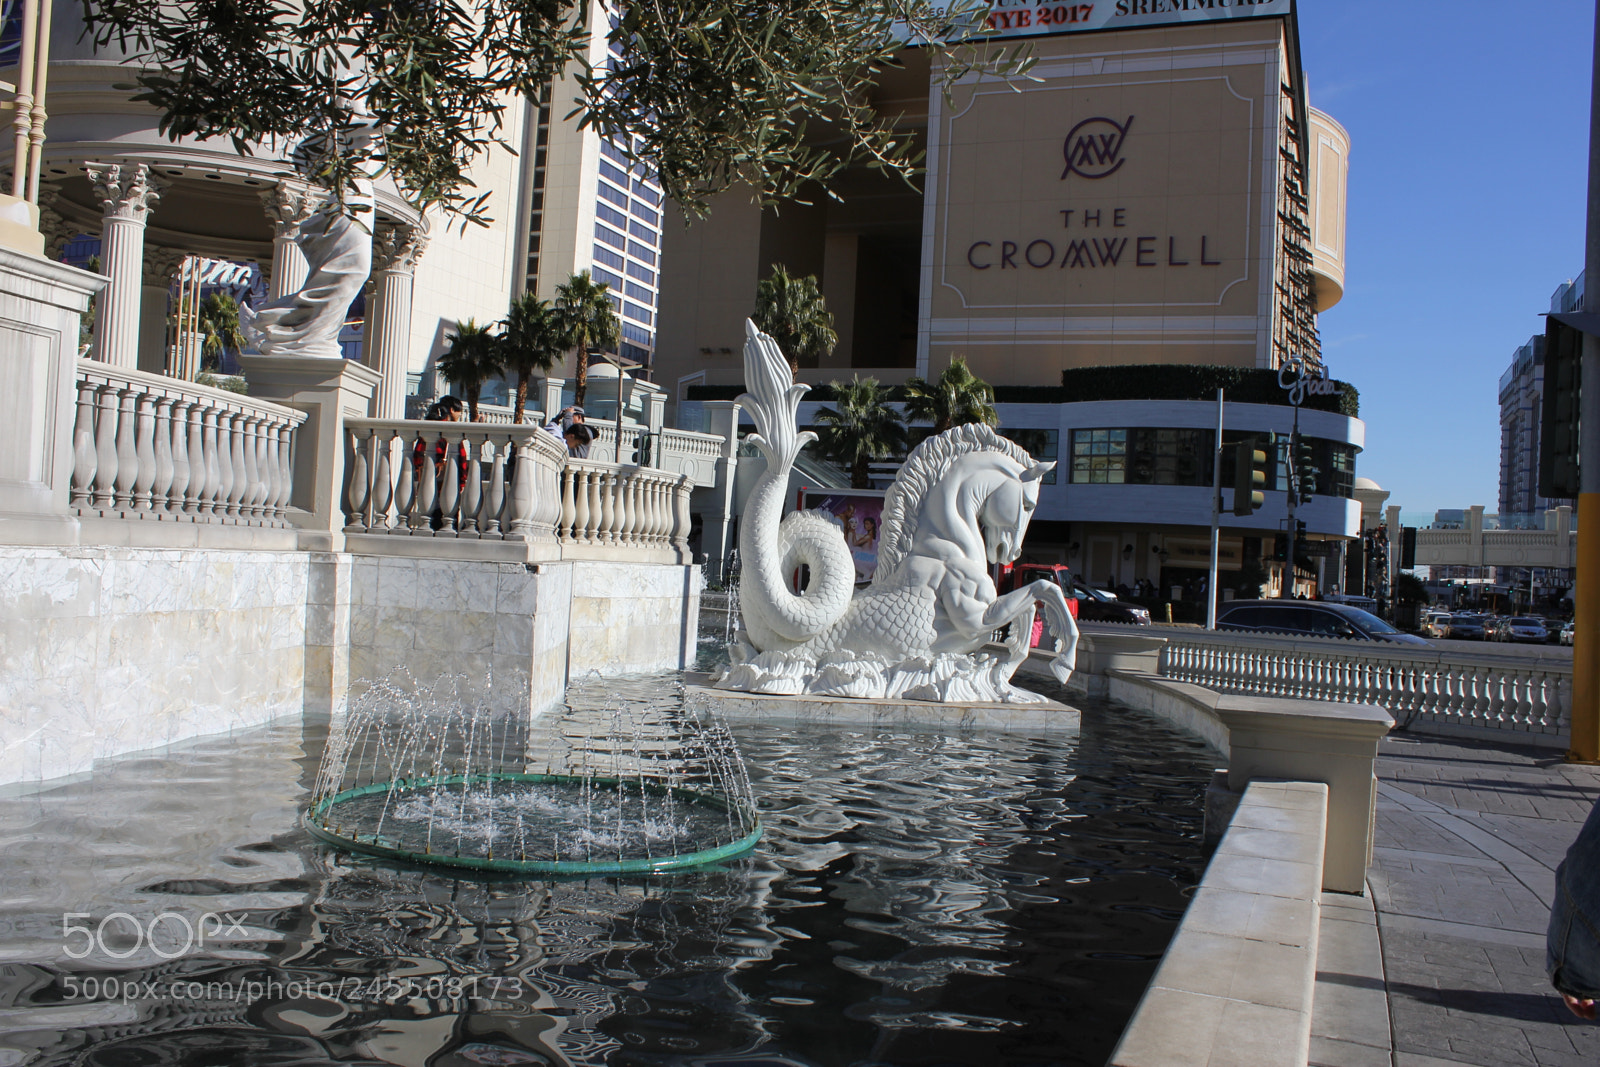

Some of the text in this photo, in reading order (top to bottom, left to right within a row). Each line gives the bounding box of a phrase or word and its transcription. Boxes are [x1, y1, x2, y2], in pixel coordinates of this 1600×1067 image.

[1036, 3, 1094, 26] 2017
[1114, 0, 1273, 17] SREMM
[1059, 208, 1126, 228] THE
[967, 235, 1222, 270] CROMWELL
[1277, 356, 1345, 406] Giada
